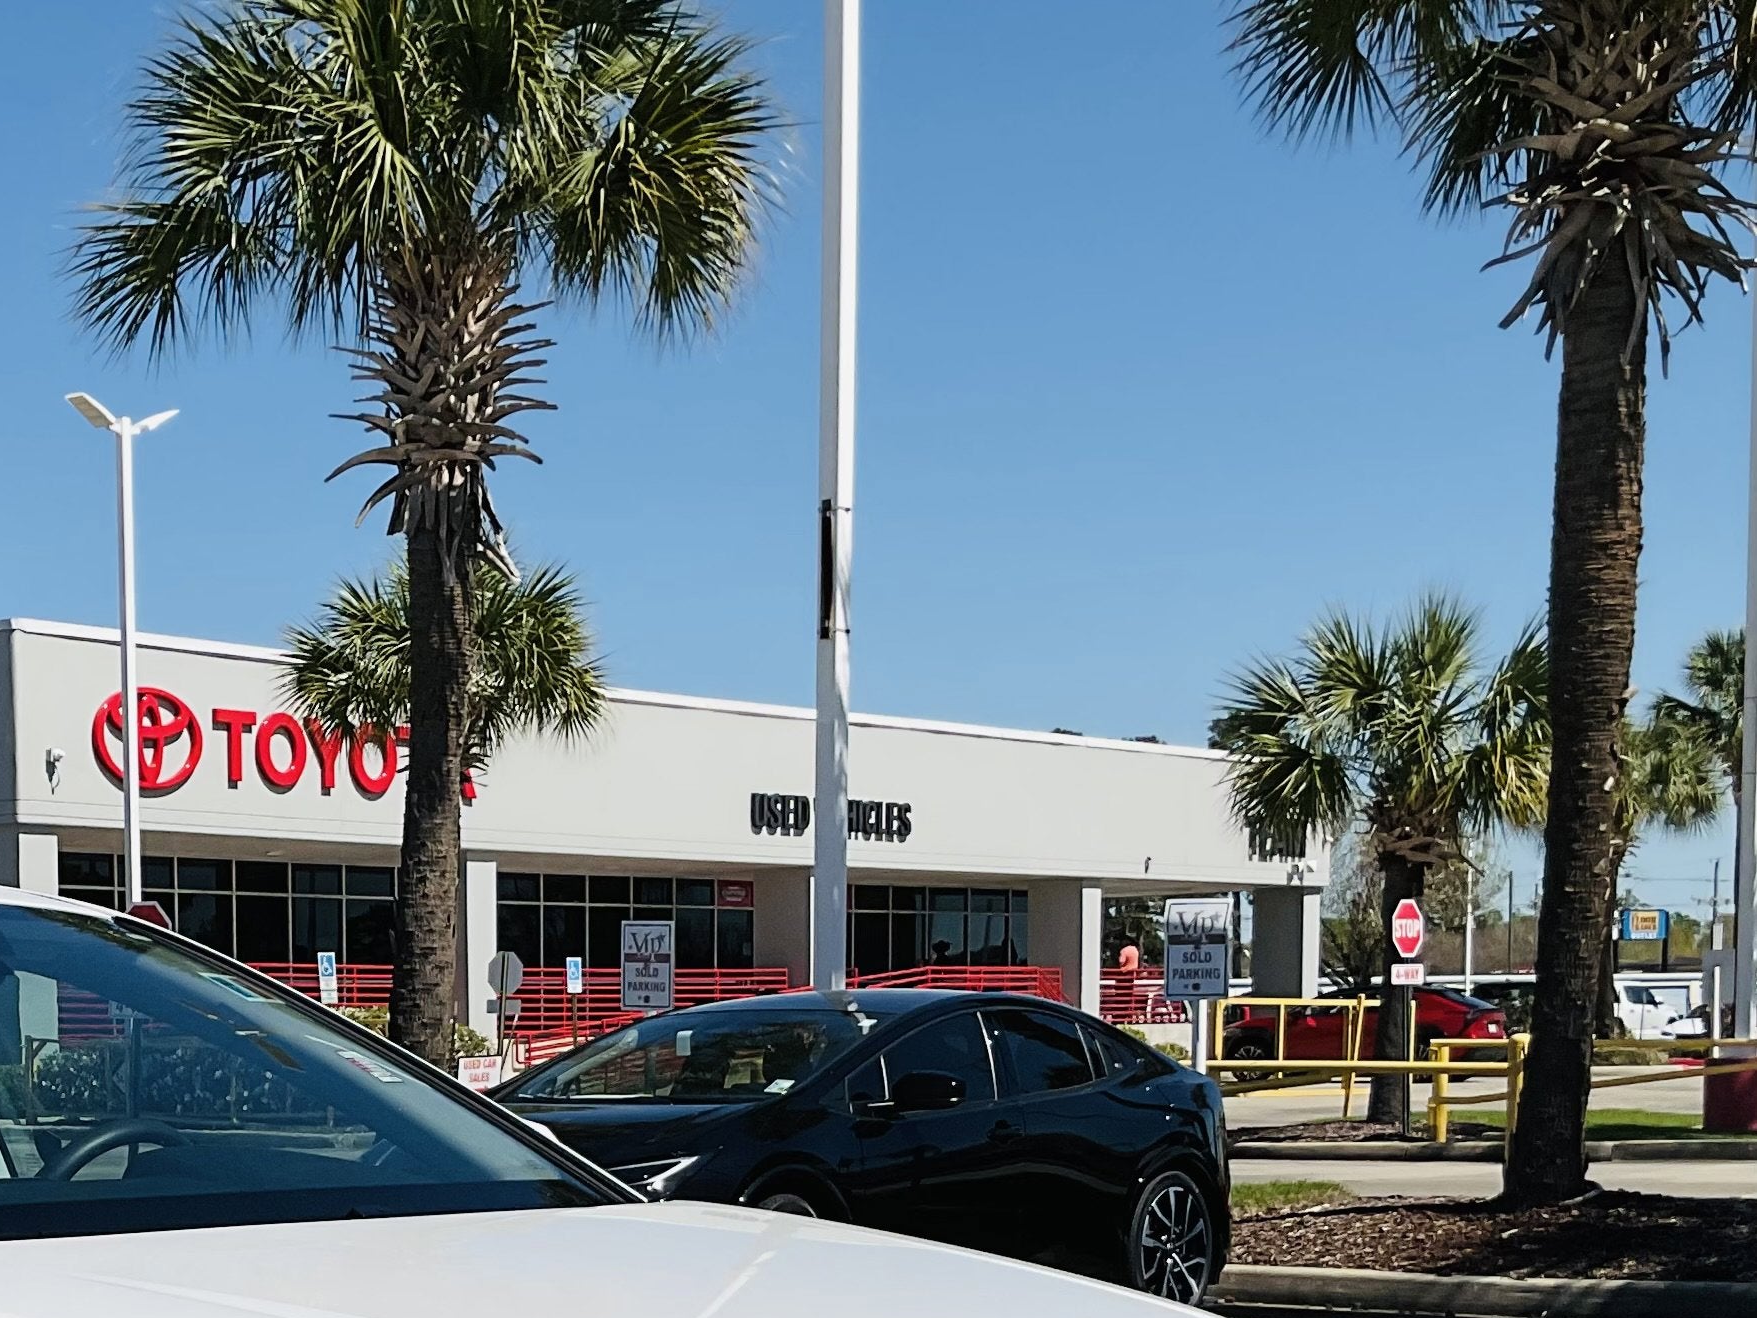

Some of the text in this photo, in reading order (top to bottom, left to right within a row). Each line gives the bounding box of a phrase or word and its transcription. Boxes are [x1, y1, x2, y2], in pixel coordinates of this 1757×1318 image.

[212, 708, 477, 799] TOYO
[750, 793, 912, 839] USED HICLES
[1395, 918, 1420, 939] STOP
[1182, 951, 1212, 963] SOLD
[635, 967, 659, 978] SOLD
[1172, 968, 1221, 979] PARKING
[1395, 968, 1420, 980] 4-WAY
[627, 981, 666, 992] PARKING
[463, 1060, 481, 1070] USED
